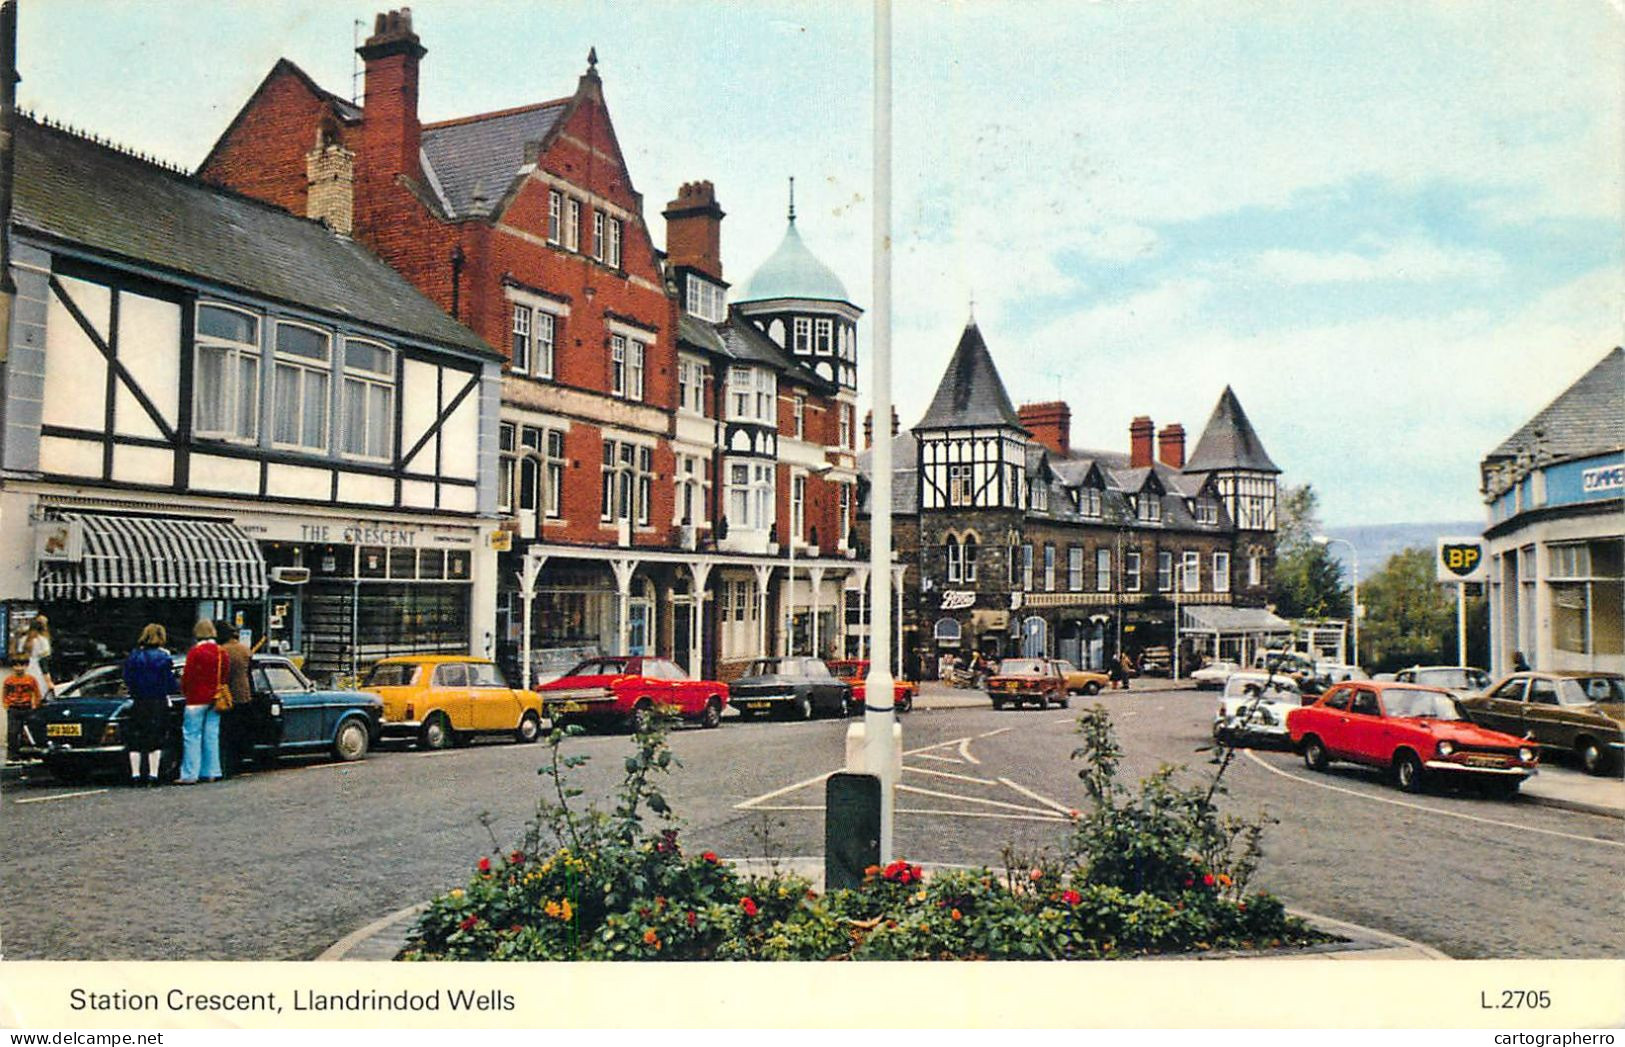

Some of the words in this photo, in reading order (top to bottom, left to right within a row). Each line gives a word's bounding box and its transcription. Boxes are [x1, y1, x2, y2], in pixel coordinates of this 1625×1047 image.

[301, 524, 329, 541] THE
[343, 526, 415, 546] CRESCENT
[1450, 548, 1478, 568] BP
